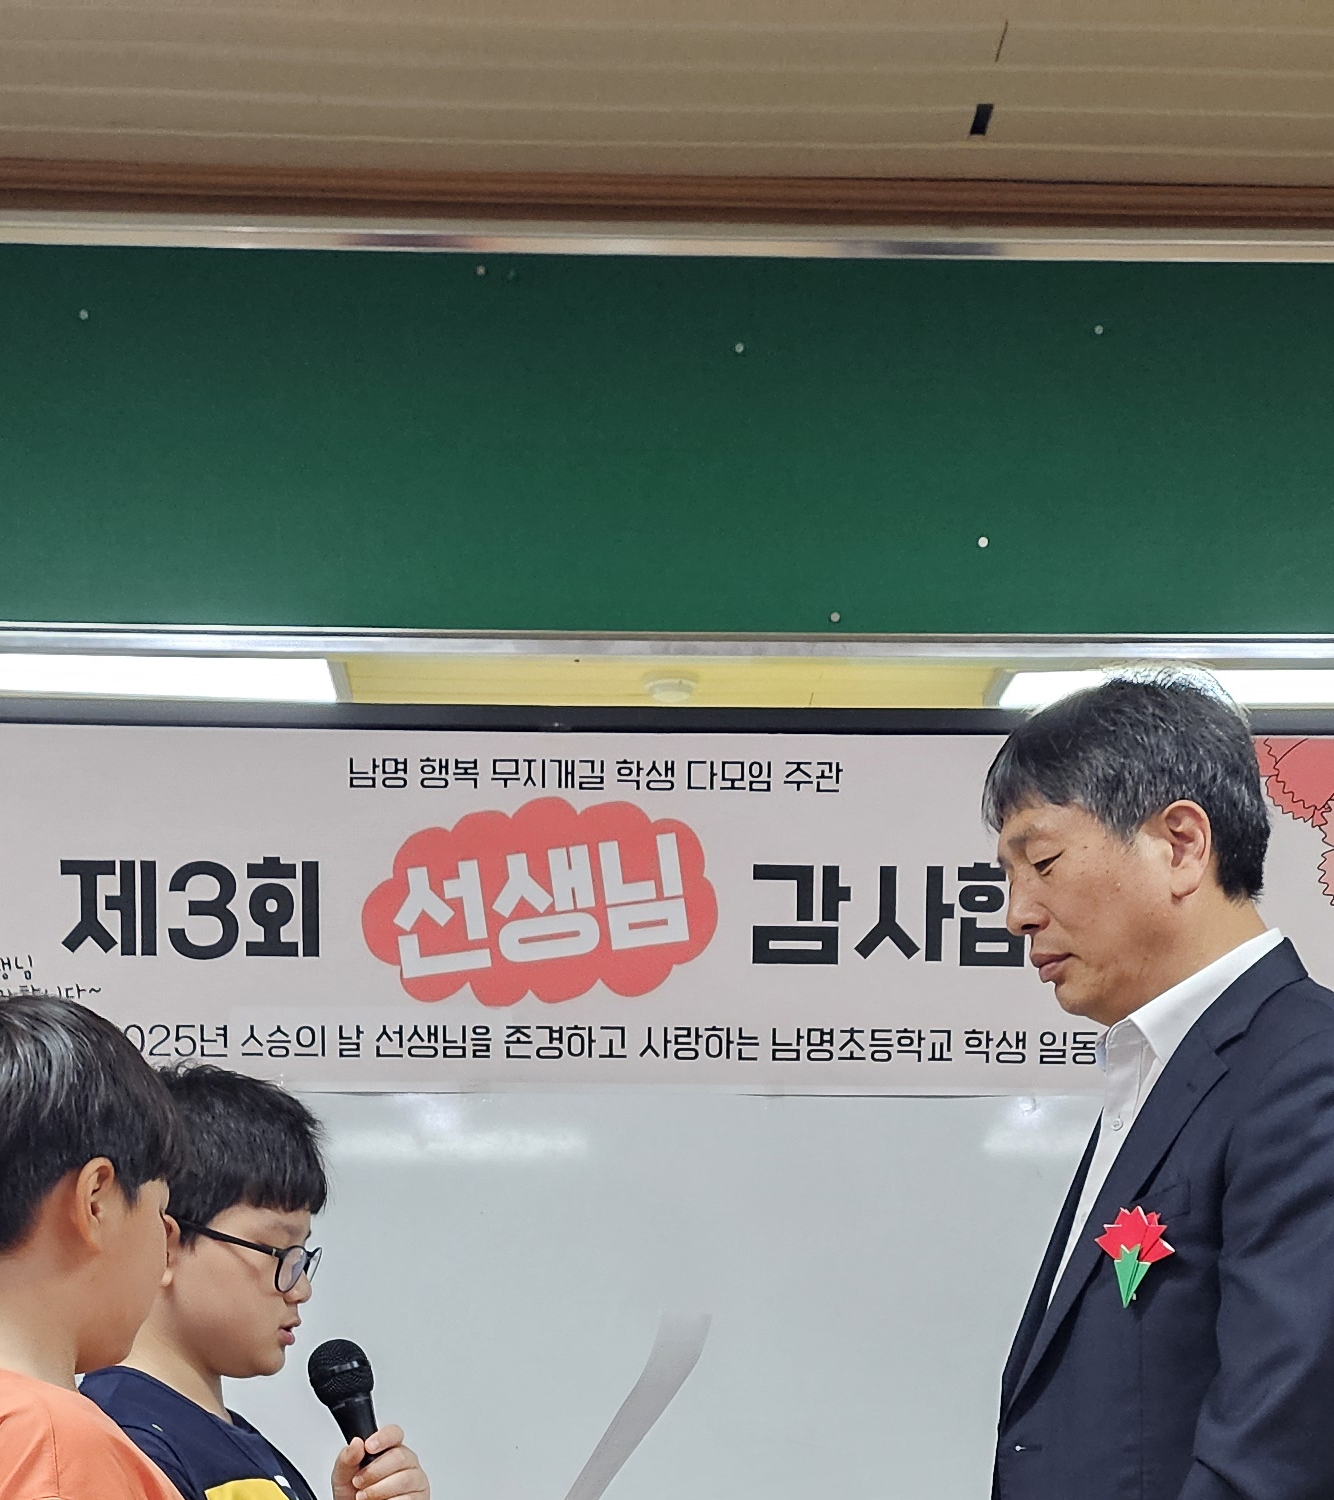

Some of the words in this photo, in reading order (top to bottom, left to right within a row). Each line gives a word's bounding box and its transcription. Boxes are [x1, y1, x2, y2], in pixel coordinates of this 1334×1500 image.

[349, 757, 408, 789] 남명
[419, 756, 480, 790] 행복
[490, 758, 605, 791] 무지개길
[615, 758, 675, 792] 학생
[686, 760, 772, 793] 다모임
[783, 760, 844, 793] 주관
[59, 856, 320, 960] 제3회
[393, 832, 689, 979] 선생님
[123, 1024, 228, 1057] 025년
[241, 1024, 326, 1057] 스승의
[338, 1024, 365, 1058] 날
[375, 1024, 492, 1059] 선생님을
[503, 1024, 628, 1060] 존경하고
[639, 1025, 760, 1061] 사랑하는
[771, 1026, 953, 1063] 남명초등학교
[963, 1028, 1027, 1064] 학생
[1039, 1031, 1098, 1065] 일동
